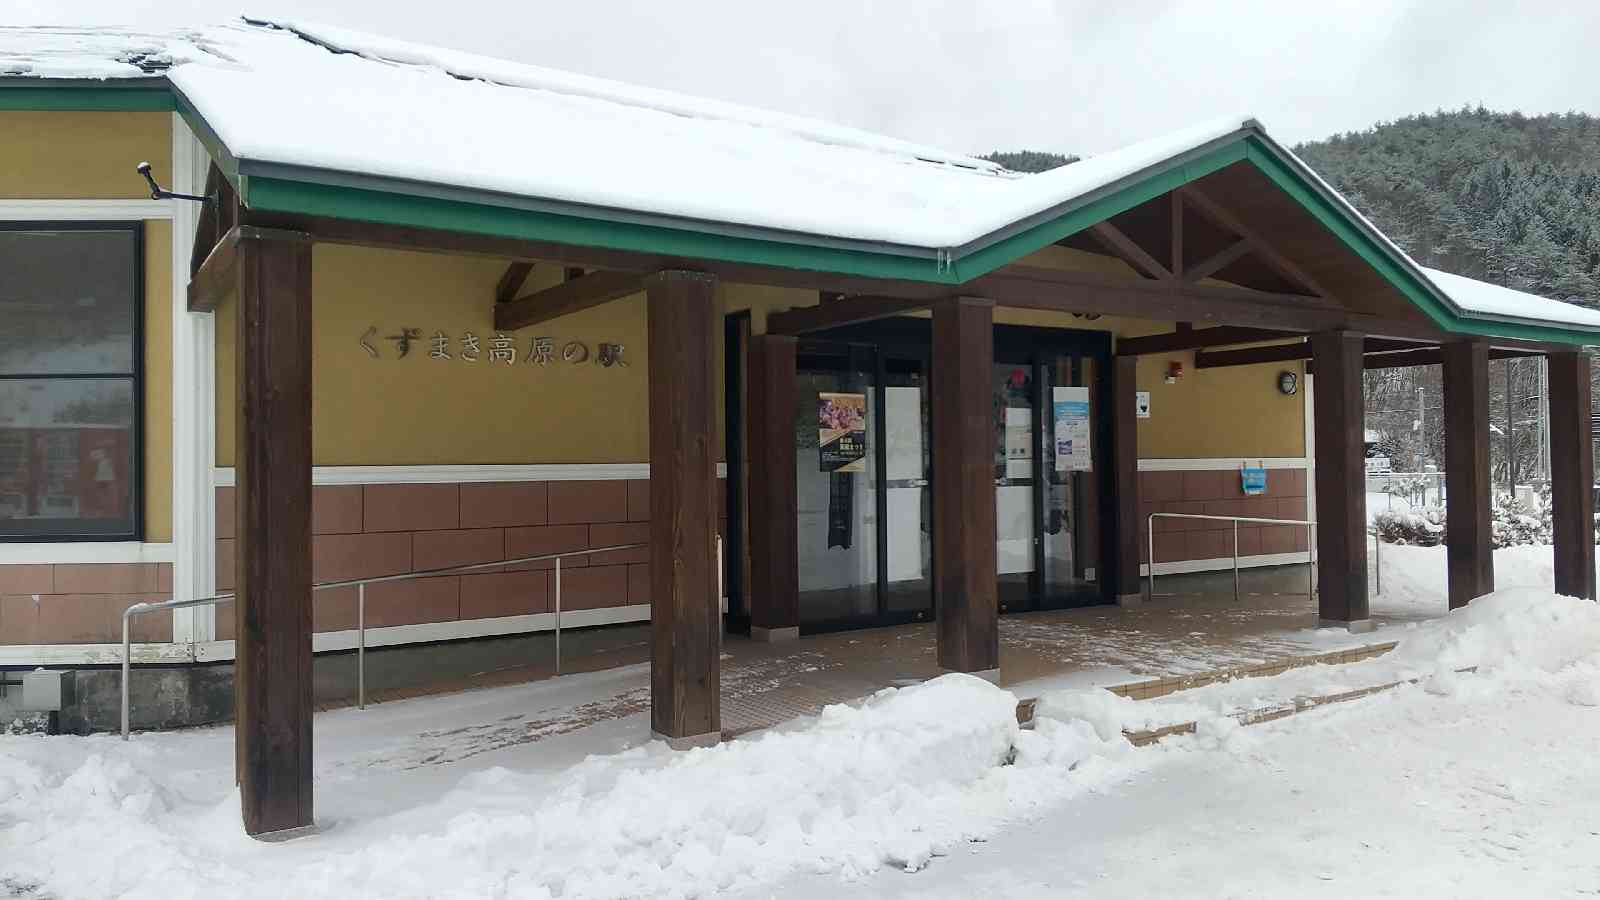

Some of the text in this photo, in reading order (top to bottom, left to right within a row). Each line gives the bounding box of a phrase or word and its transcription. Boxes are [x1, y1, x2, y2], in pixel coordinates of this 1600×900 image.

[358, 327, 630, 367] くずまき高原の駅
